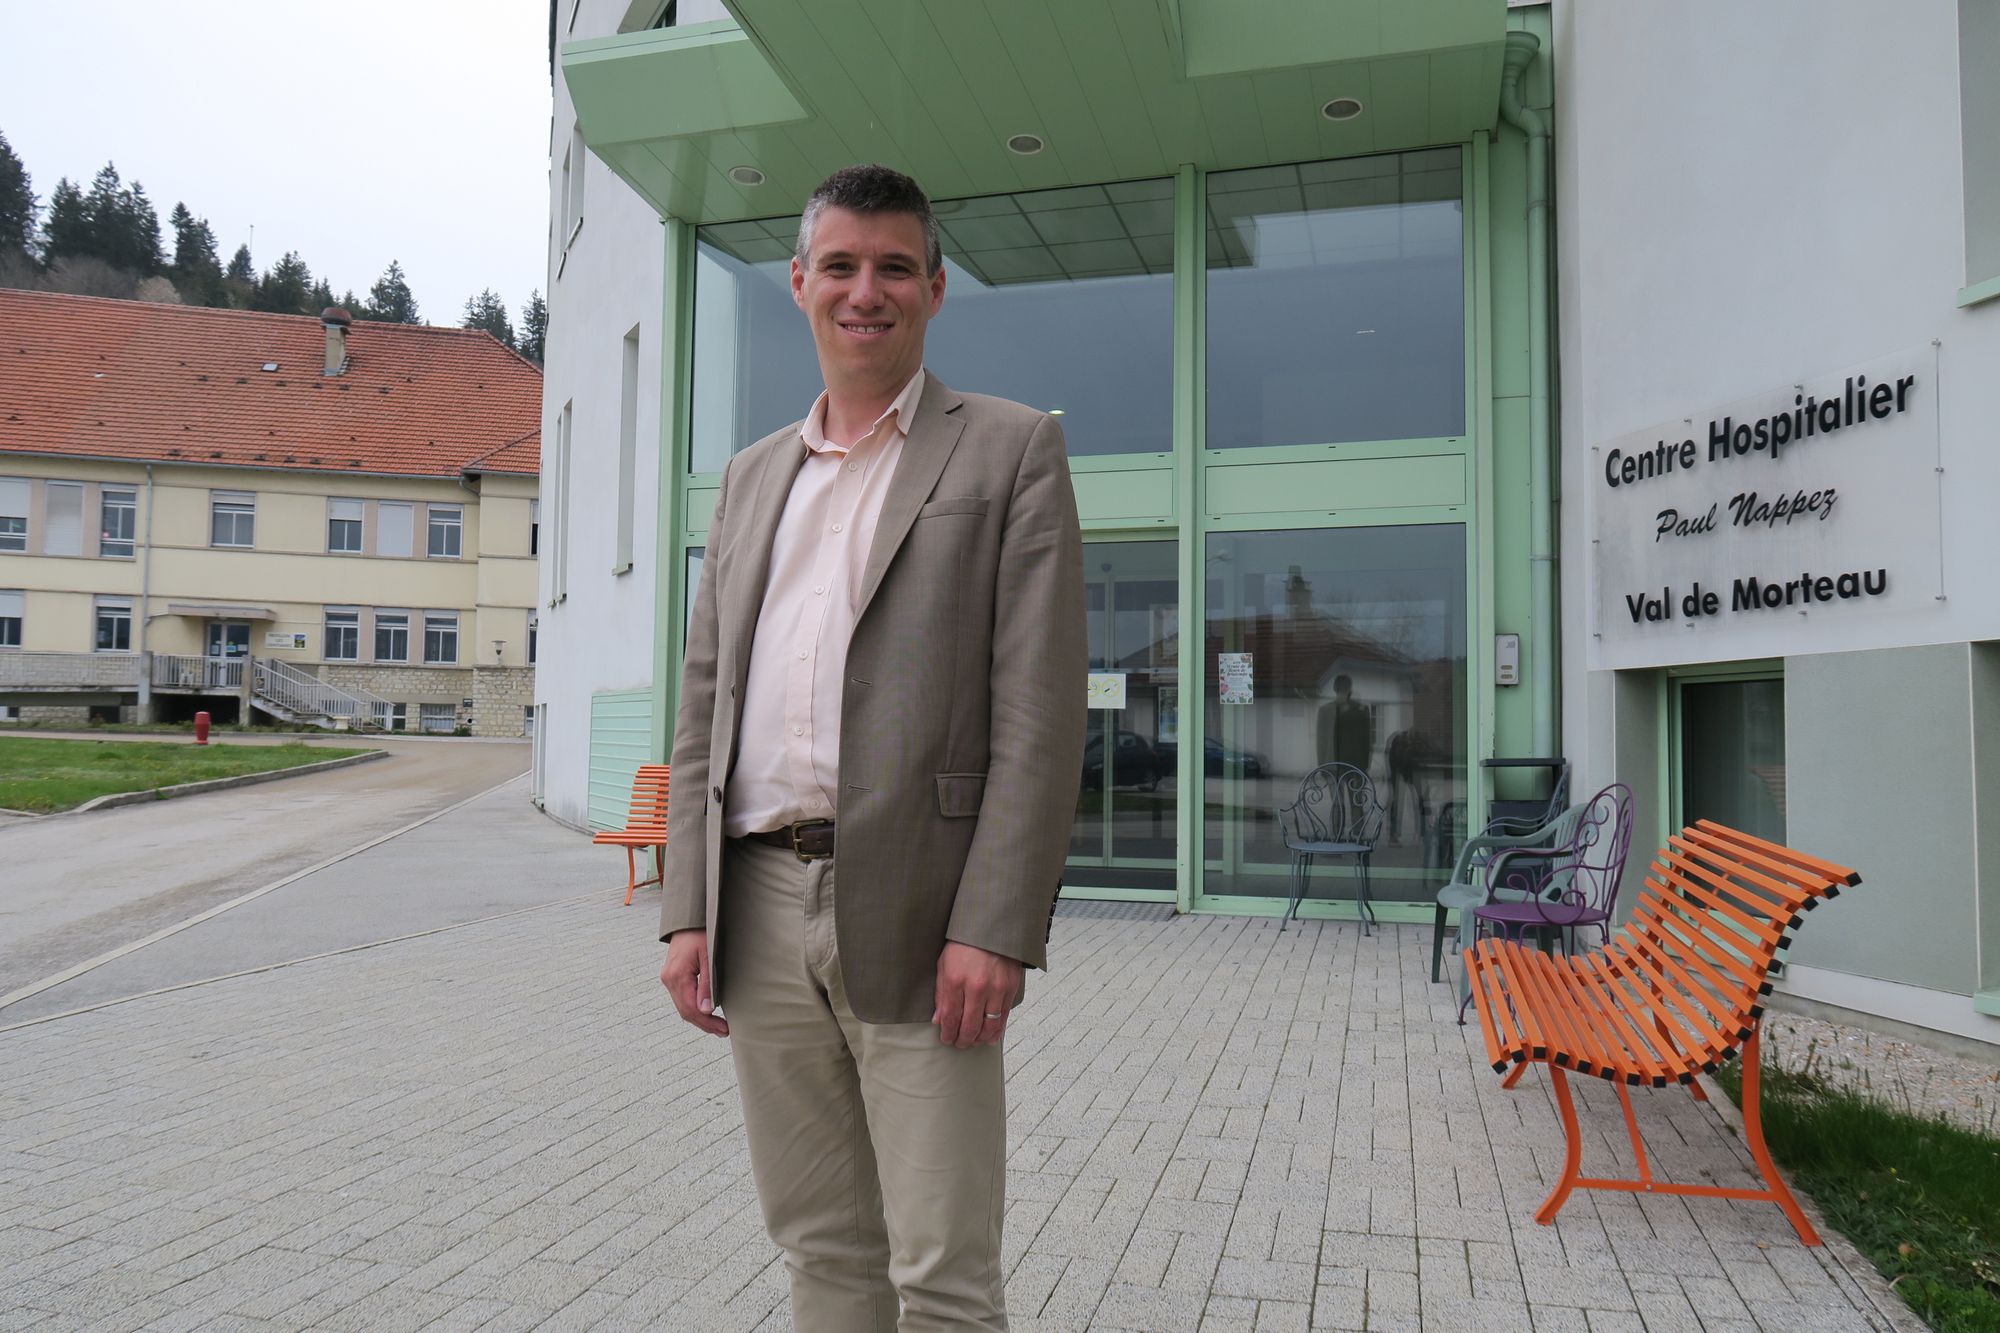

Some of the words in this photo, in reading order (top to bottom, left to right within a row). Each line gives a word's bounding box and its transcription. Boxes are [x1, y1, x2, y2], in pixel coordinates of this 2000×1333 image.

[1605, 438, 1696, 488] Centre
[1708, 374, 1914, 461] Hospitalier
[1655, 502, 1717, 543] Paul
[1727, 487, 1837, 529] Nappez
[1625, 586, 1672, 624] Val
[1681, 582, 1720, 618] de
[1731, 568, 1887, 612] Morteau
